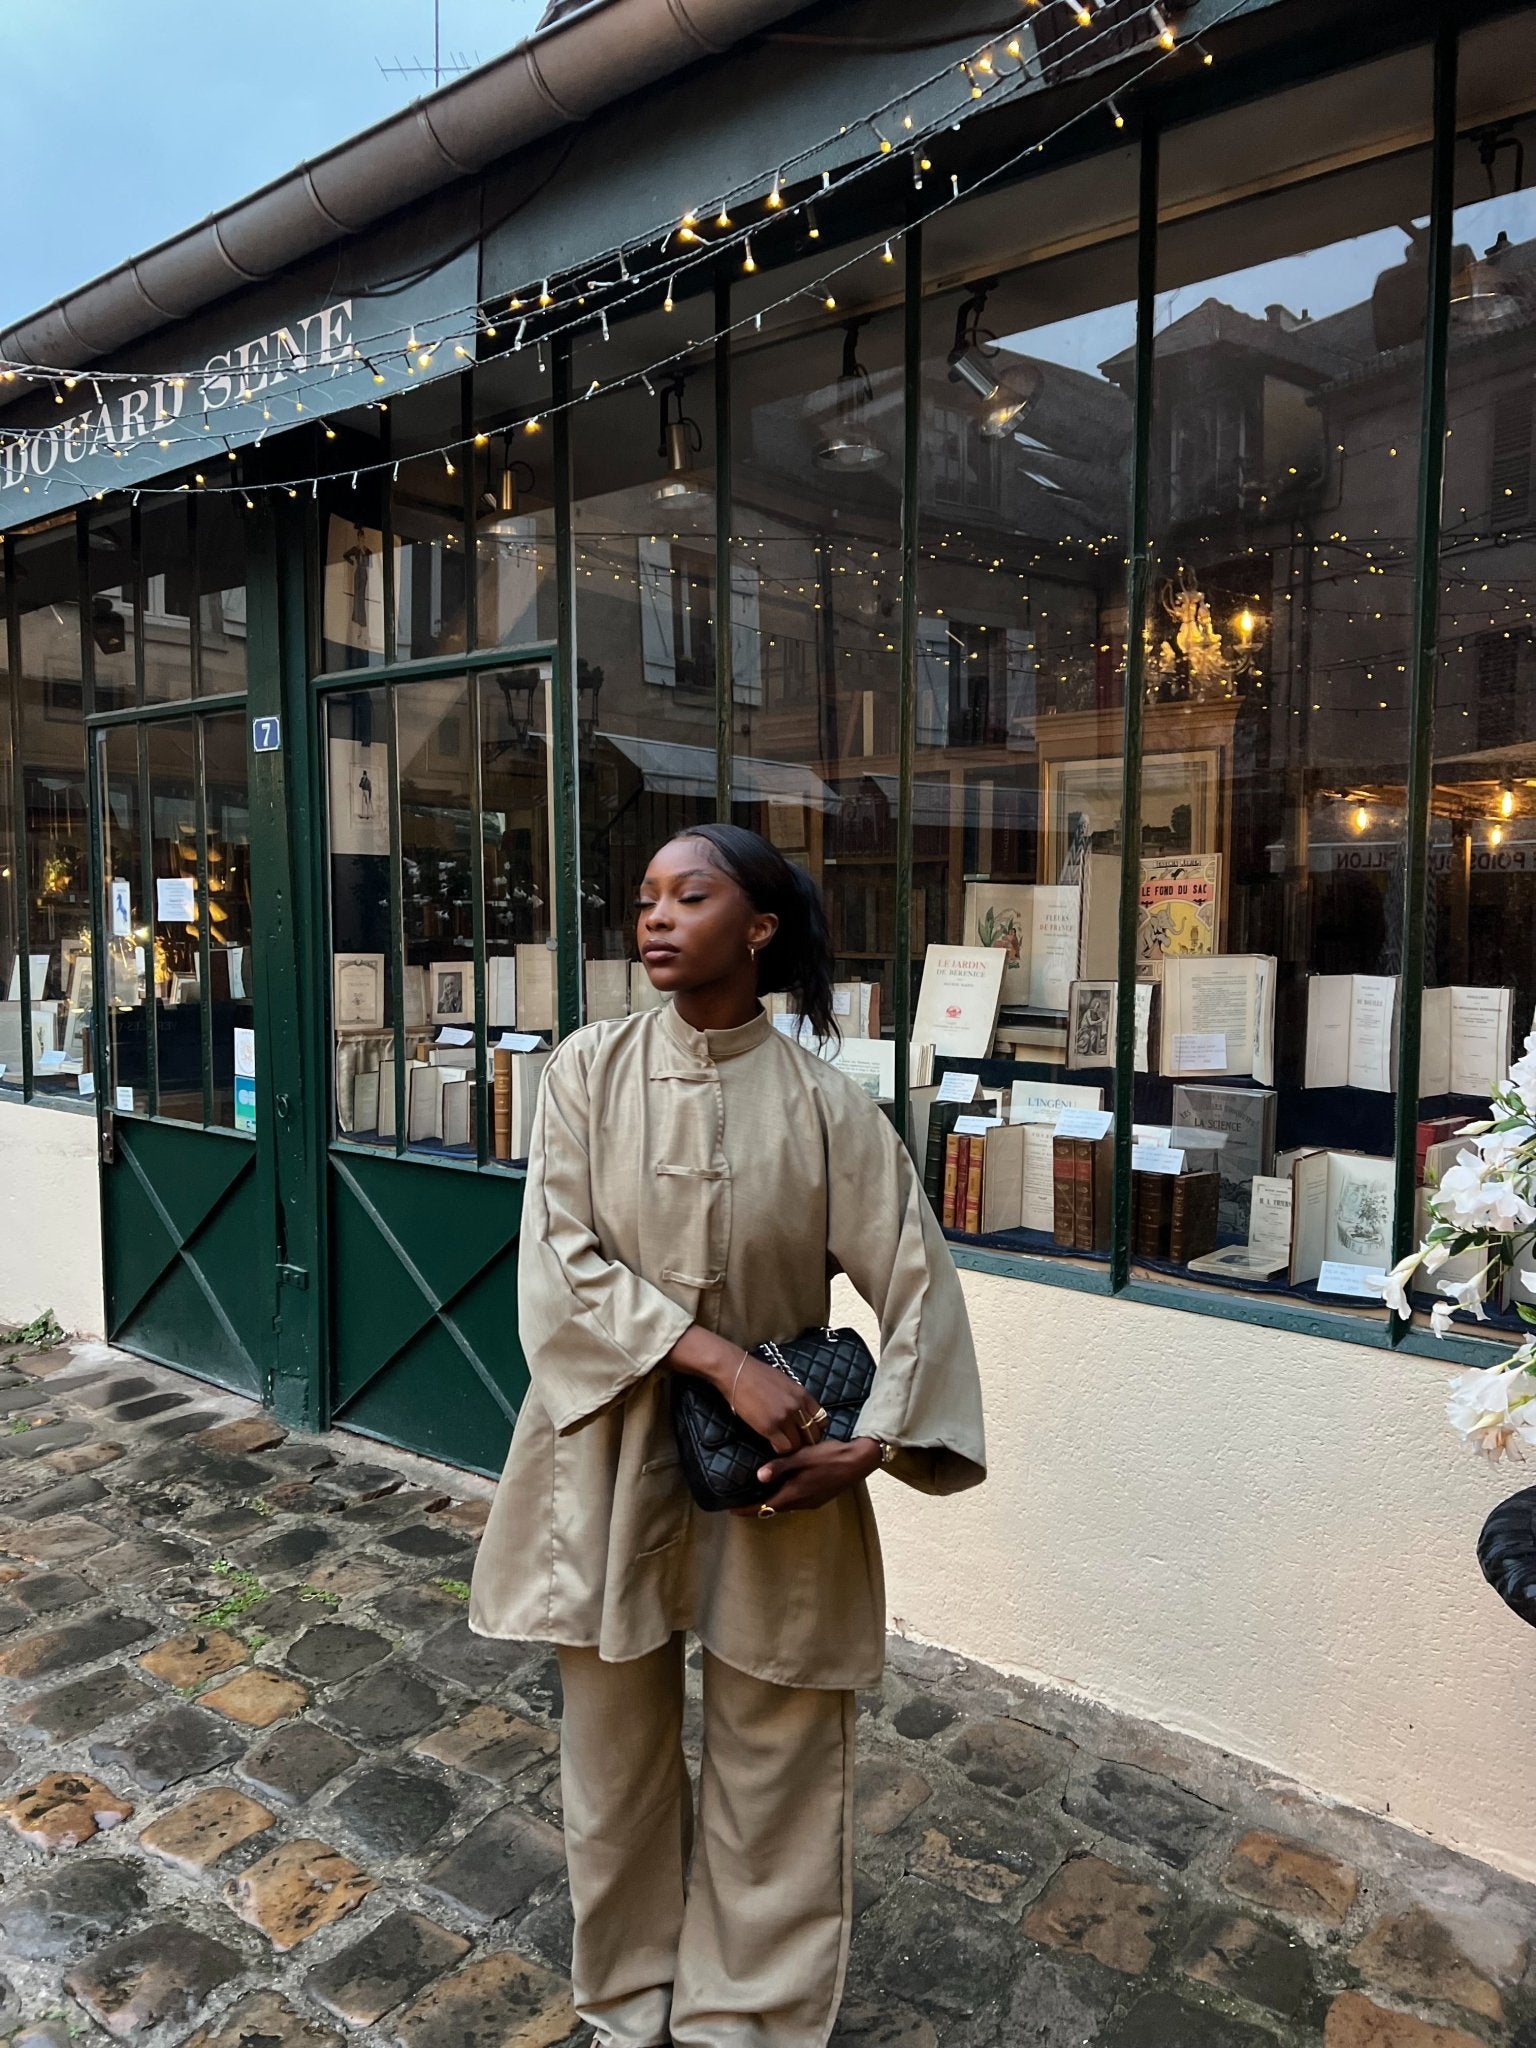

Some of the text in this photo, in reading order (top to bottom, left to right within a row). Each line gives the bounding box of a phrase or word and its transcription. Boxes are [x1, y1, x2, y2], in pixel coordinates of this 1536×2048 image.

[203, 299, 353, 411] SENE
[262, 723, 270, 746] 7
[1141, 883, 1207, 897] LE FOND DU SAC
[937, 959, 987, 970] LE JARDIN
[936, 968, 946, 977] DE
[1194, 1117, 1242, 1133] LA SCIENCE
